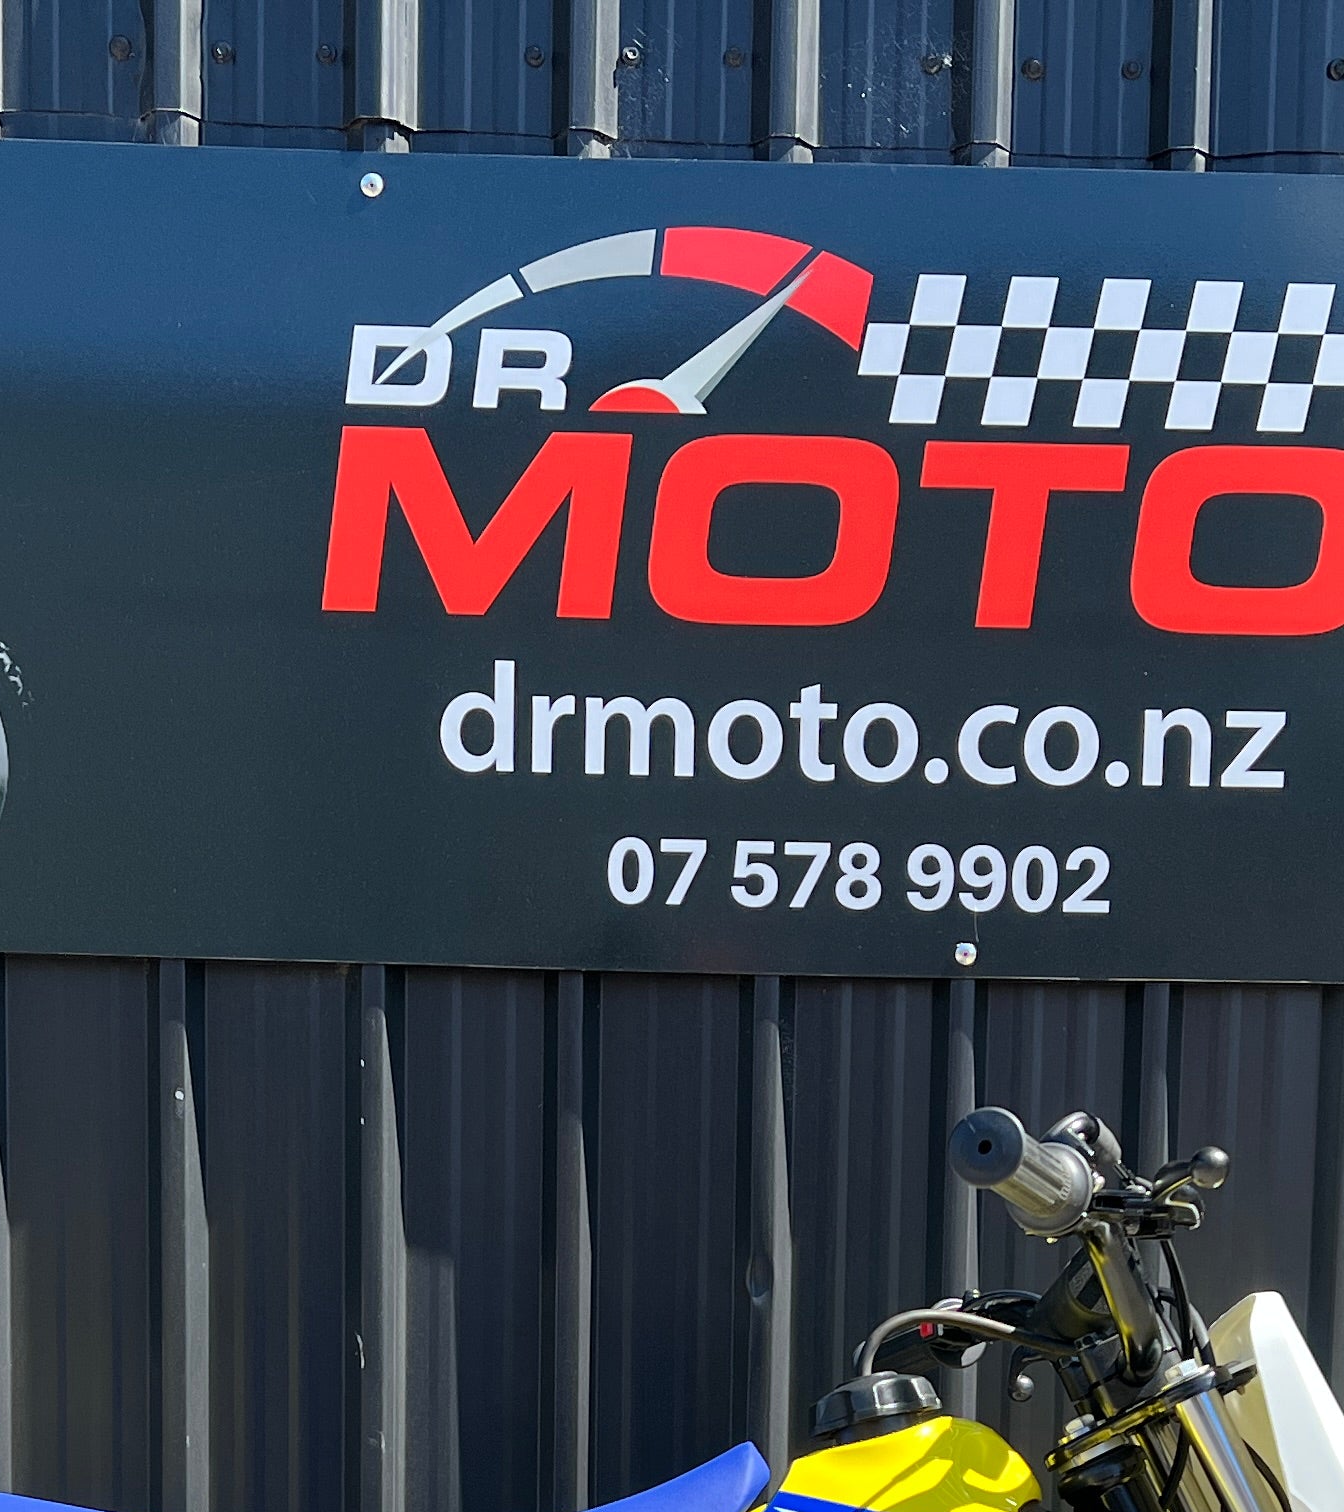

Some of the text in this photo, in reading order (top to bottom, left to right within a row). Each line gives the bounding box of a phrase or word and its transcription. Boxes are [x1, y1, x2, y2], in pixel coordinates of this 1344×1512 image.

[345, 324, 573, 411] DR
[439, 659, 1287, 789] drmoto.co.nz
[607, 836, 1110, 914] 07 578 9902
